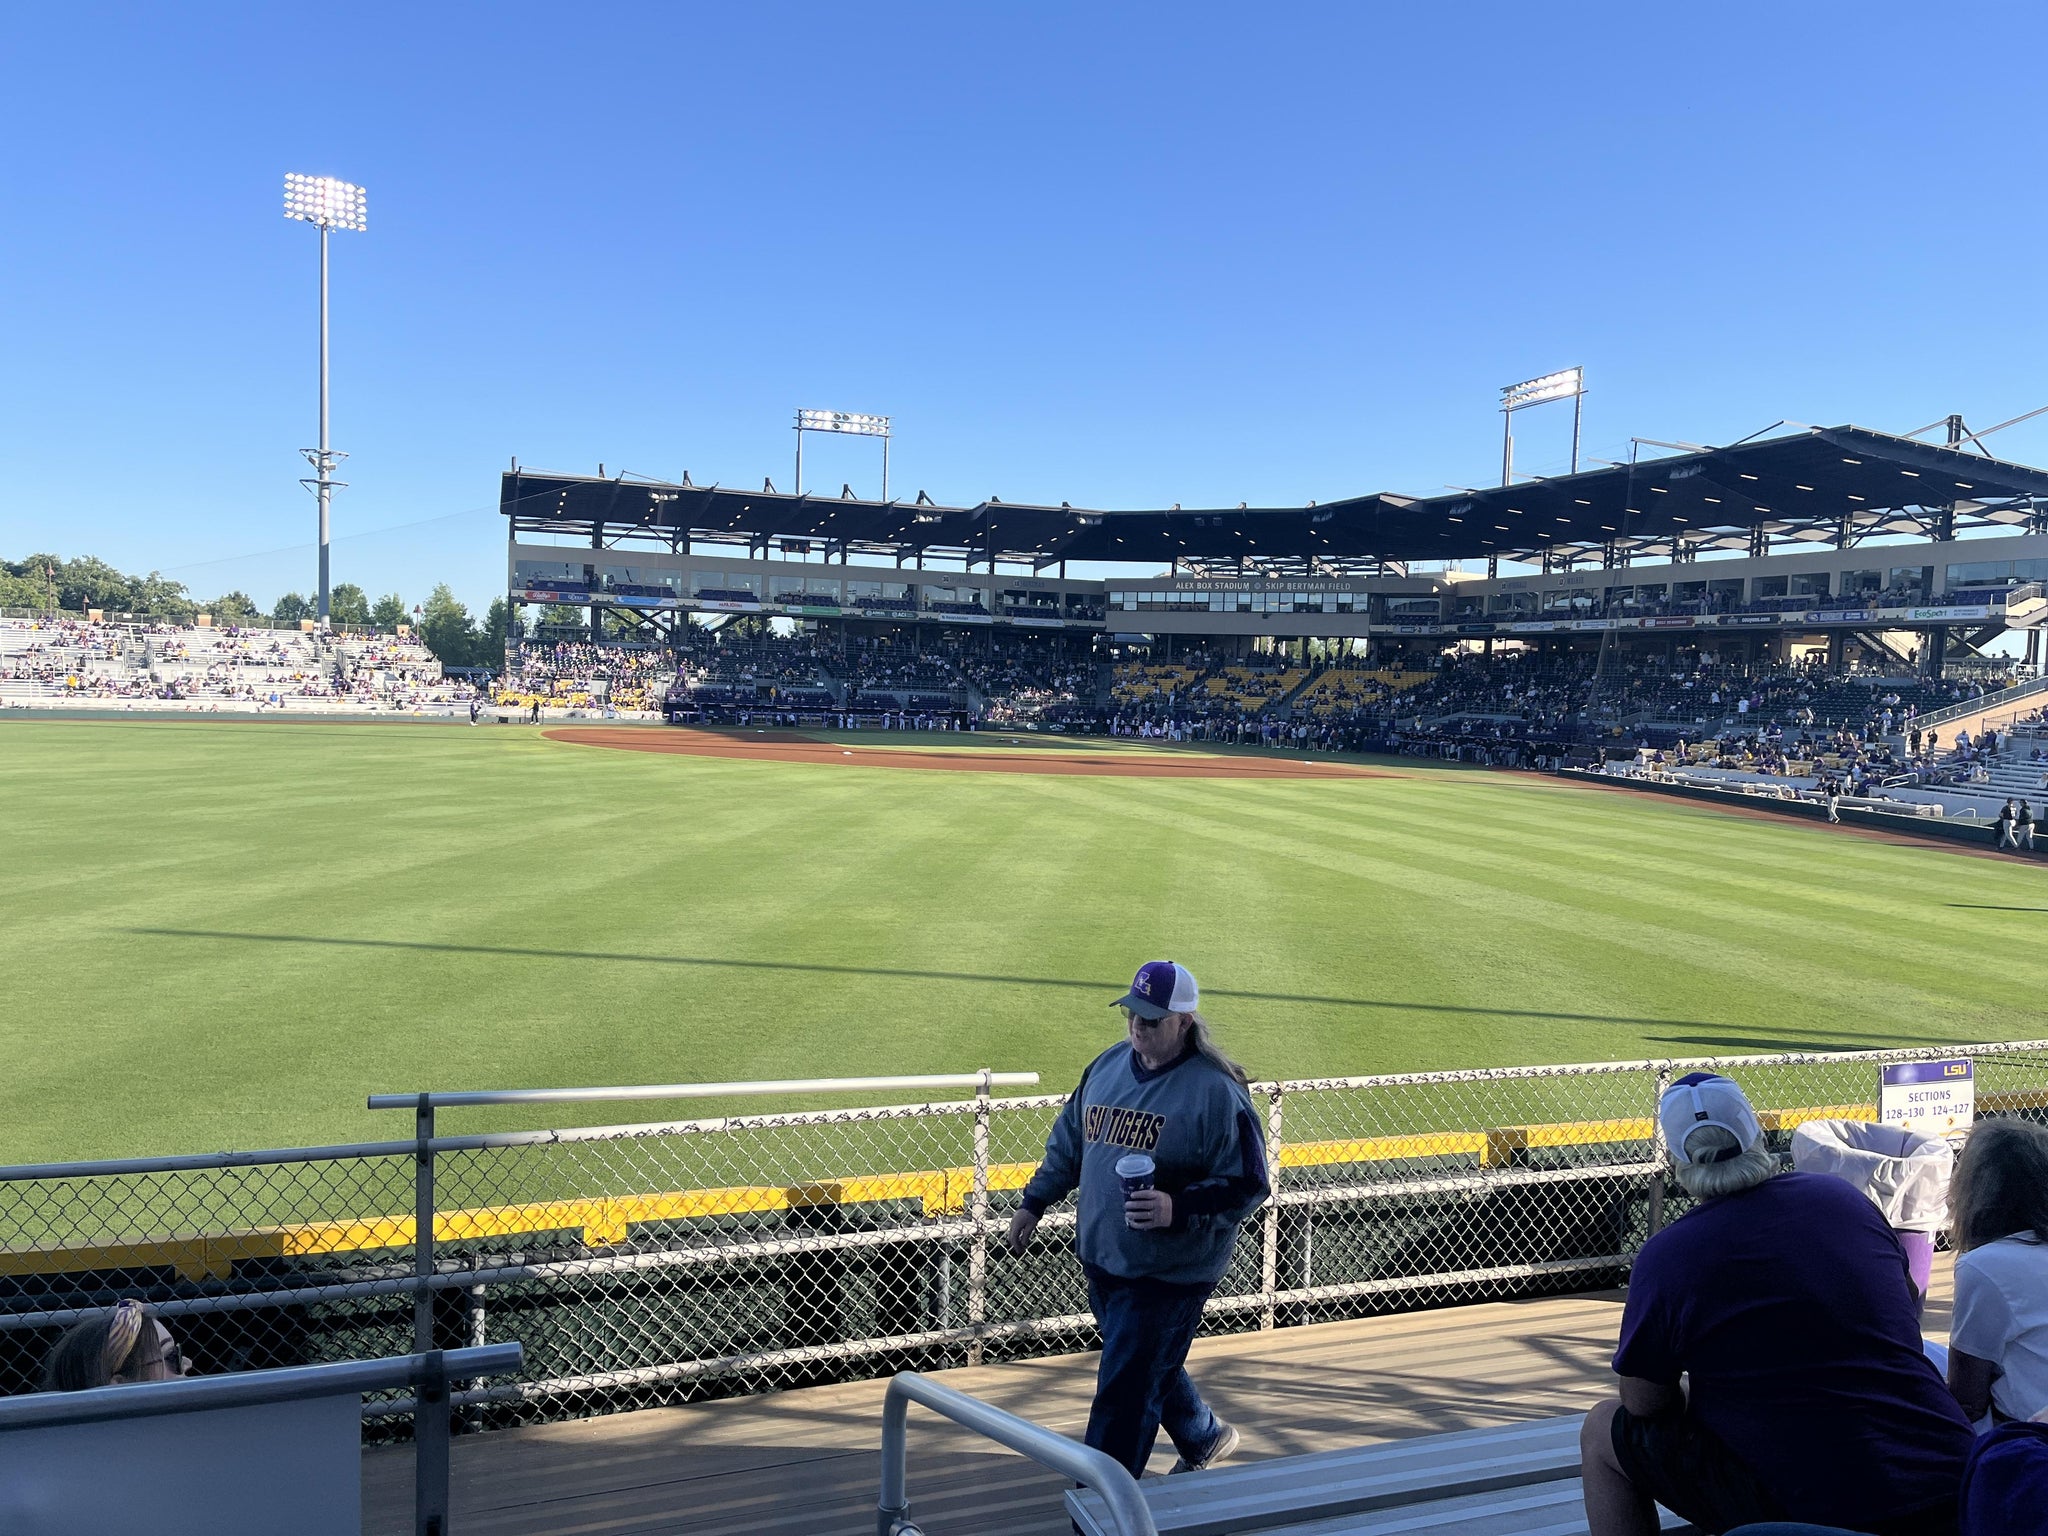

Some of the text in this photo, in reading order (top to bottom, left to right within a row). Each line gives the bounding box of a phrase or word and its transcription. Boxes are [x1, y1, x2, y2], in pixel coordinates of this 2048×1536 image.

[1175, 582, 1351, 591] ALEX BOX STADIUM SKIP BERTMAN FIELD
[1914, 608, 1947, 619] EcoSport
[1943, 1063, 1967, 1077] LSU
[1908, 1090, 1951, 1103] SECTIONS
[1886, 1103, 1970, 1120] 128-130 124-127
[1104, 1106, 1167, 1151] TIGERS
